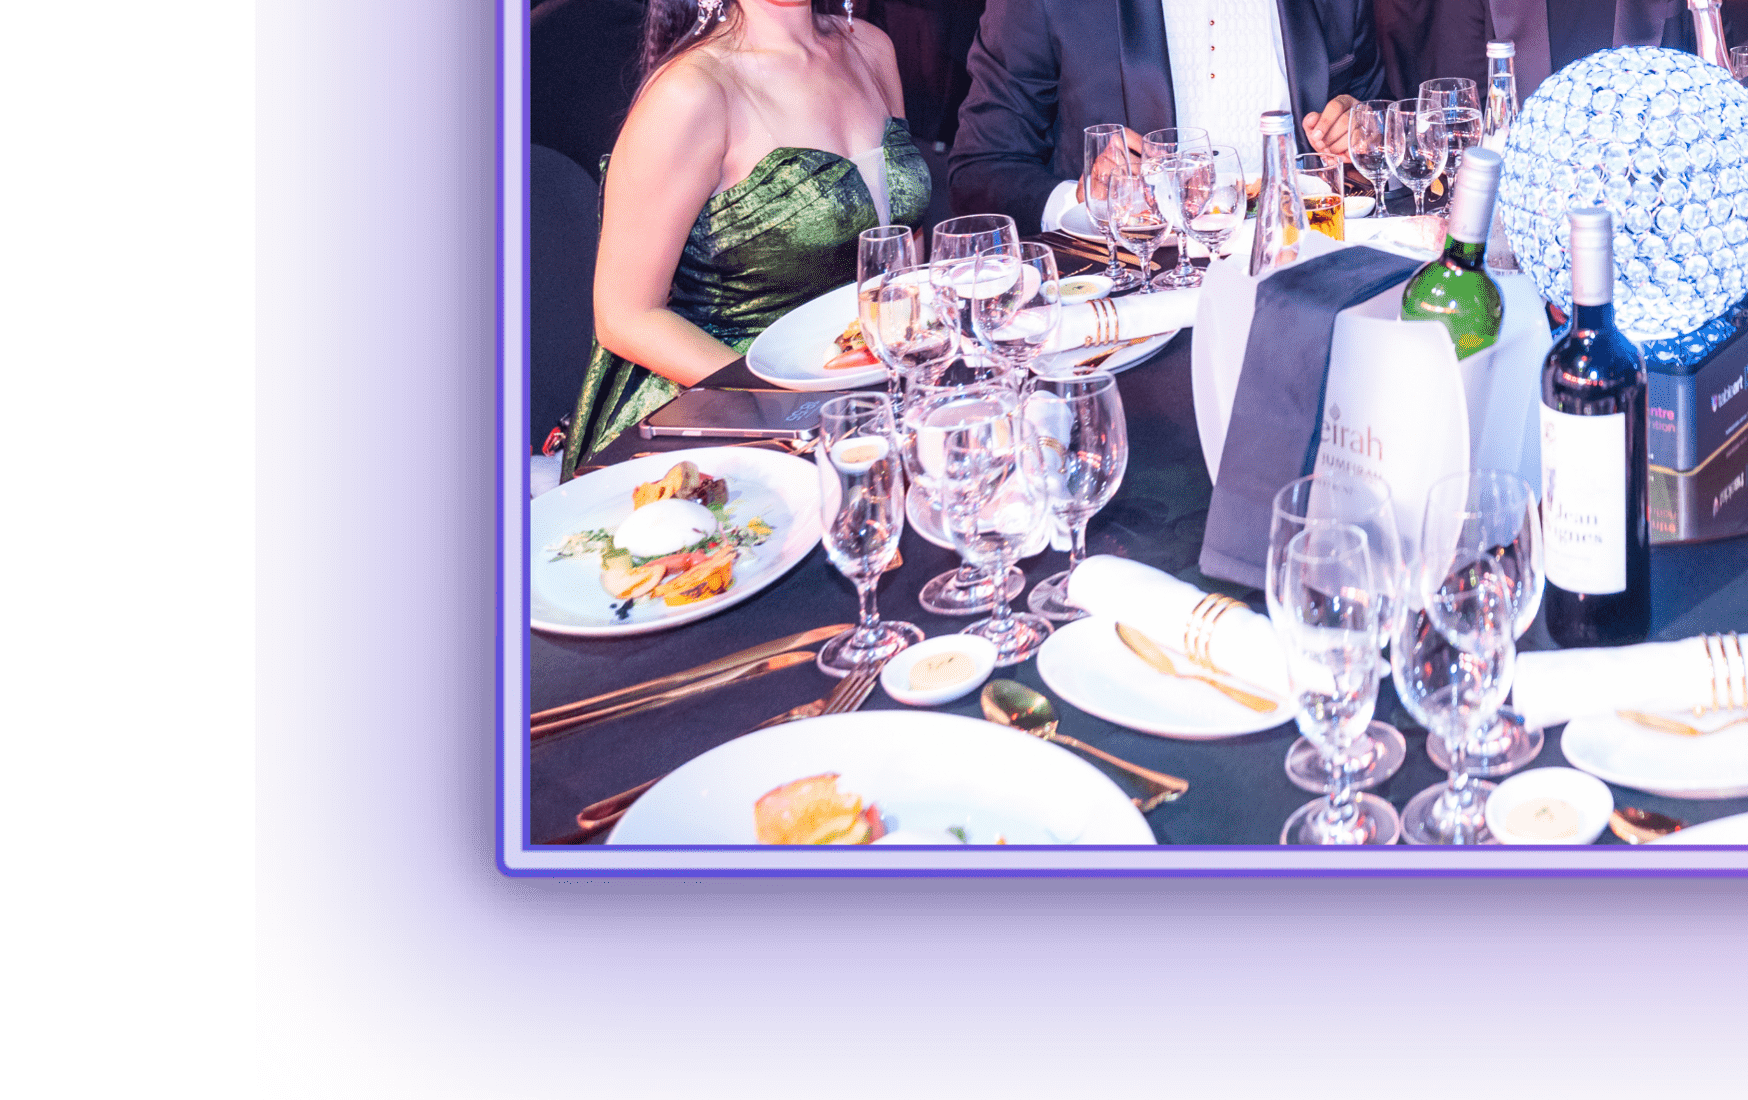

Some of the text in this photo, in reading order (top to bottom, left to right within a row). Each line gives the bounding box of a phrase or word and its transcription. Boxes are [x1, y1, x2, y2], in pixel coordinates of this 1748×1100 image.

[1649, 407, 1676, 421] ntre
[1320, 404, 1384, 462] eirah
[1548, 524, 1604, 545] ignes
